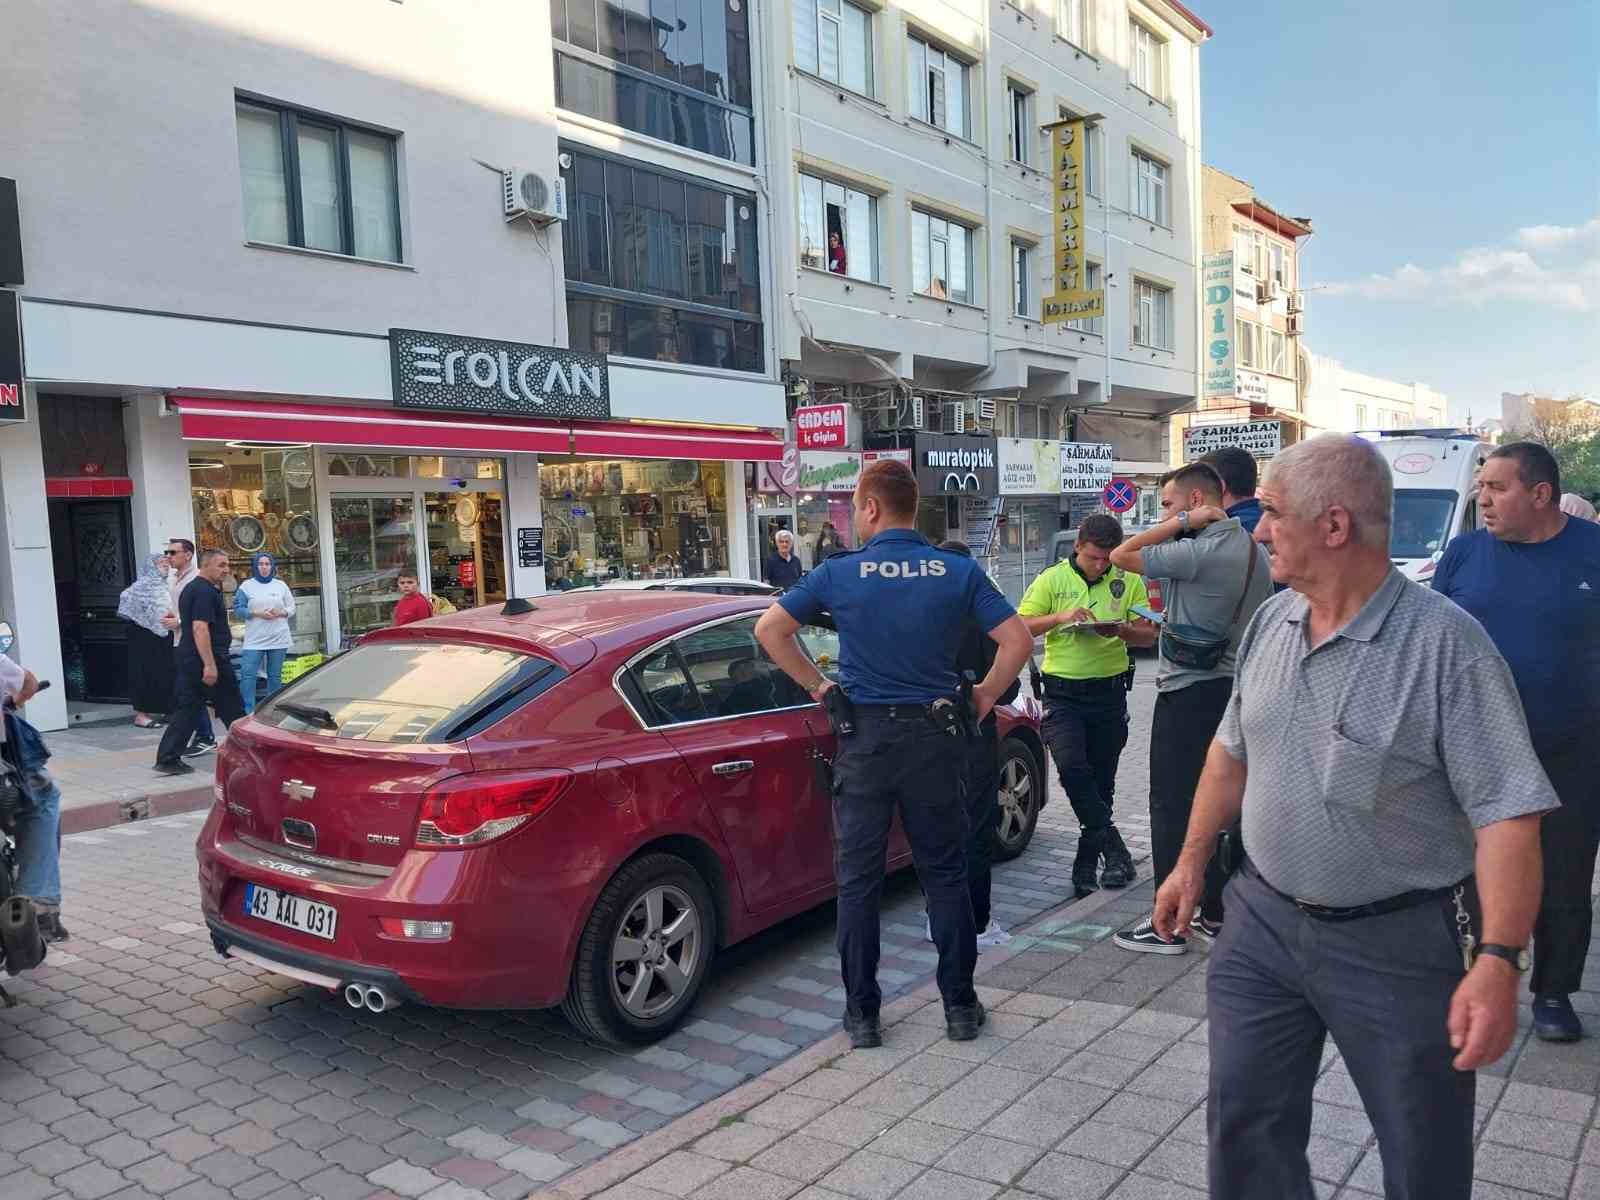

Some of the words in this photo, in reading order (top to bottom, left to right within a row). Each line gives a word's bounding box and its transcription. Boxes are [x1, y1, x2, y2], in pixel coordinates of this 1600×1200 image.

[798, 410, 843, 429] ERDEM
[1200, 422, 1280, 439] ŞAHMARAN
[1220, 434, 1240, 445] DİŞ
[1242, 432, 1277, 442] SAĞLIĞI
[928, 447, 994, 472] muratoptik
[1067, 446, 1112, 463] ŞAHMARAN
[253, 889, 269, 916] 43
[275, 895, 300, 927] AAL
[306, 904, 334, 936] 031
